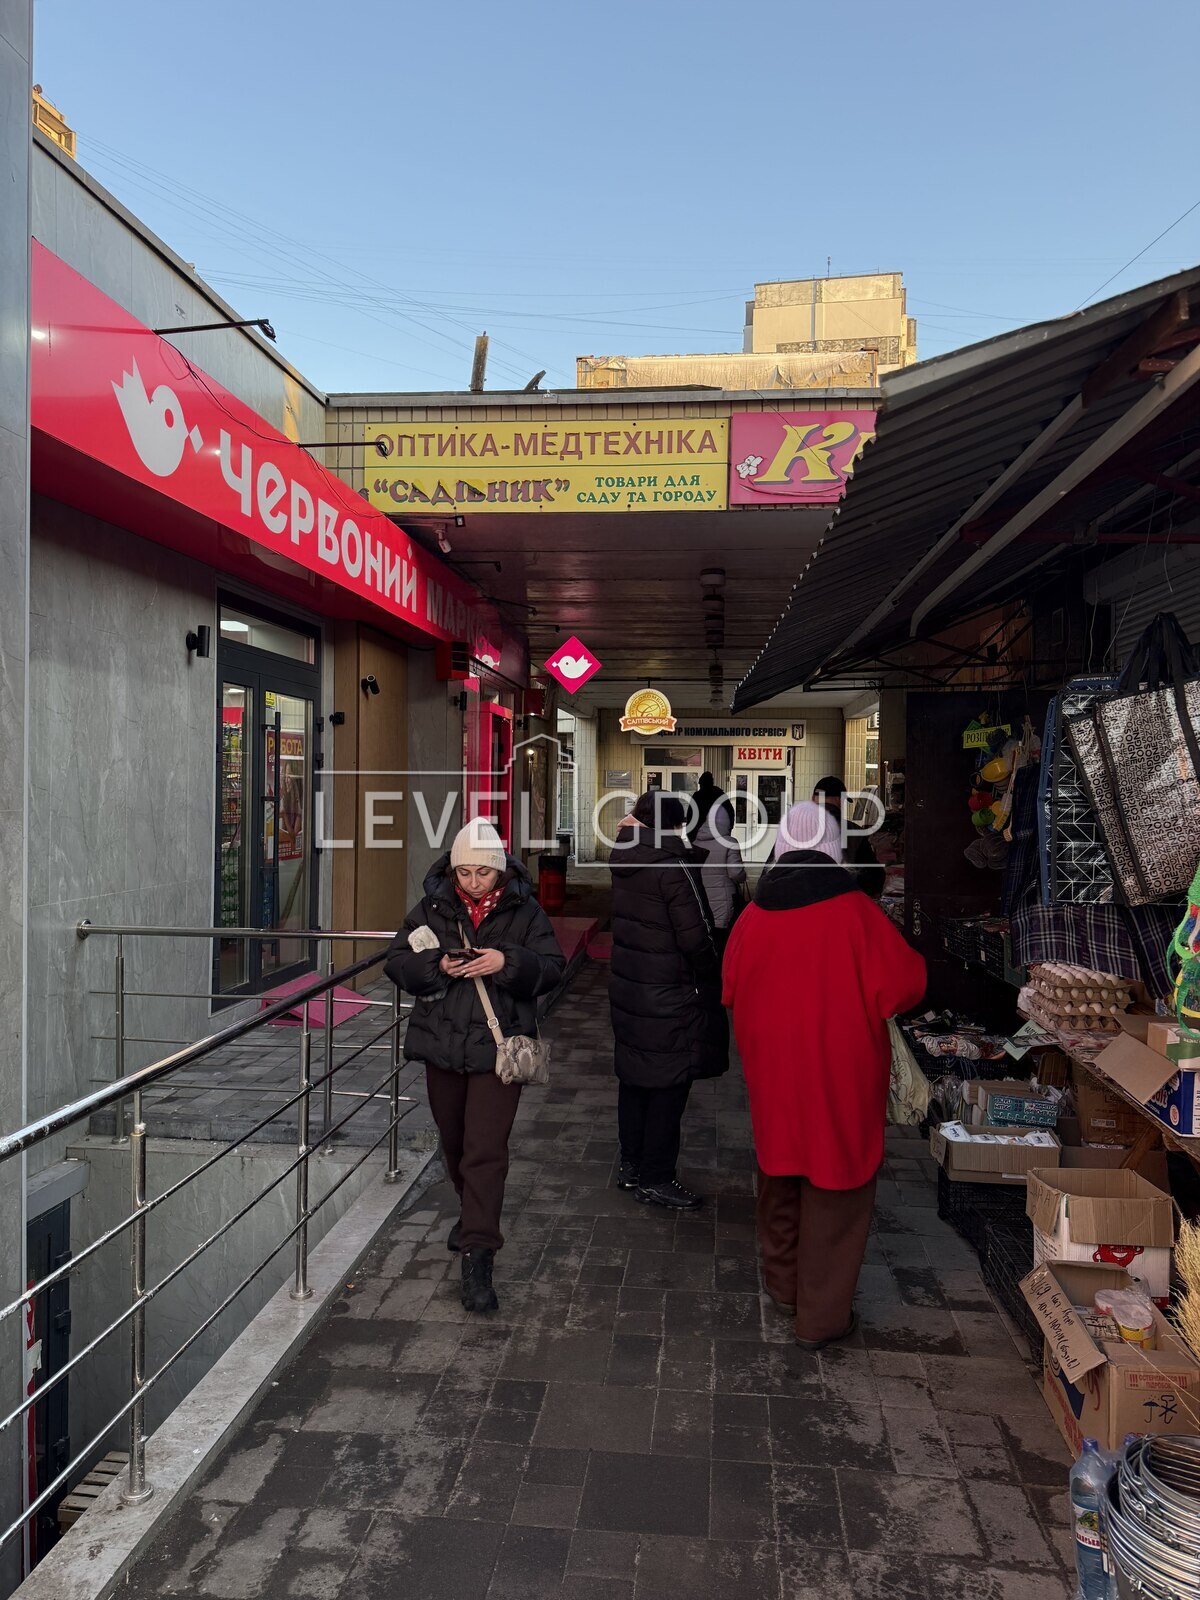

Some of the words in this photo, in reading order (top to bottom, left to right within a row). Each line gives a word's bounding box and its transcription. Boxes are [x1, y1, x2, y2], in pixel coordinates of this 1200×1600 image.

[375, 429, 718, 461] ОПТИКА-МЕДТЕХНІКА
[595, 475, 658, 489] ТОВАРИ
[664, 474, 701, 488] ДЛЯ
[577, 490, 622, 505] САДУ
[627, 490, 648, 503] ТА
[653, 489, 717, 503] ГОРОДУ
[685, 727, 751, 737] КОМУНАЛЬНОГО
[752, 727, 787, 737] СЕРВІСУ
[267, 736, 303, 755] РБОТА
[737, 747, 783, 760] КВІТИ
